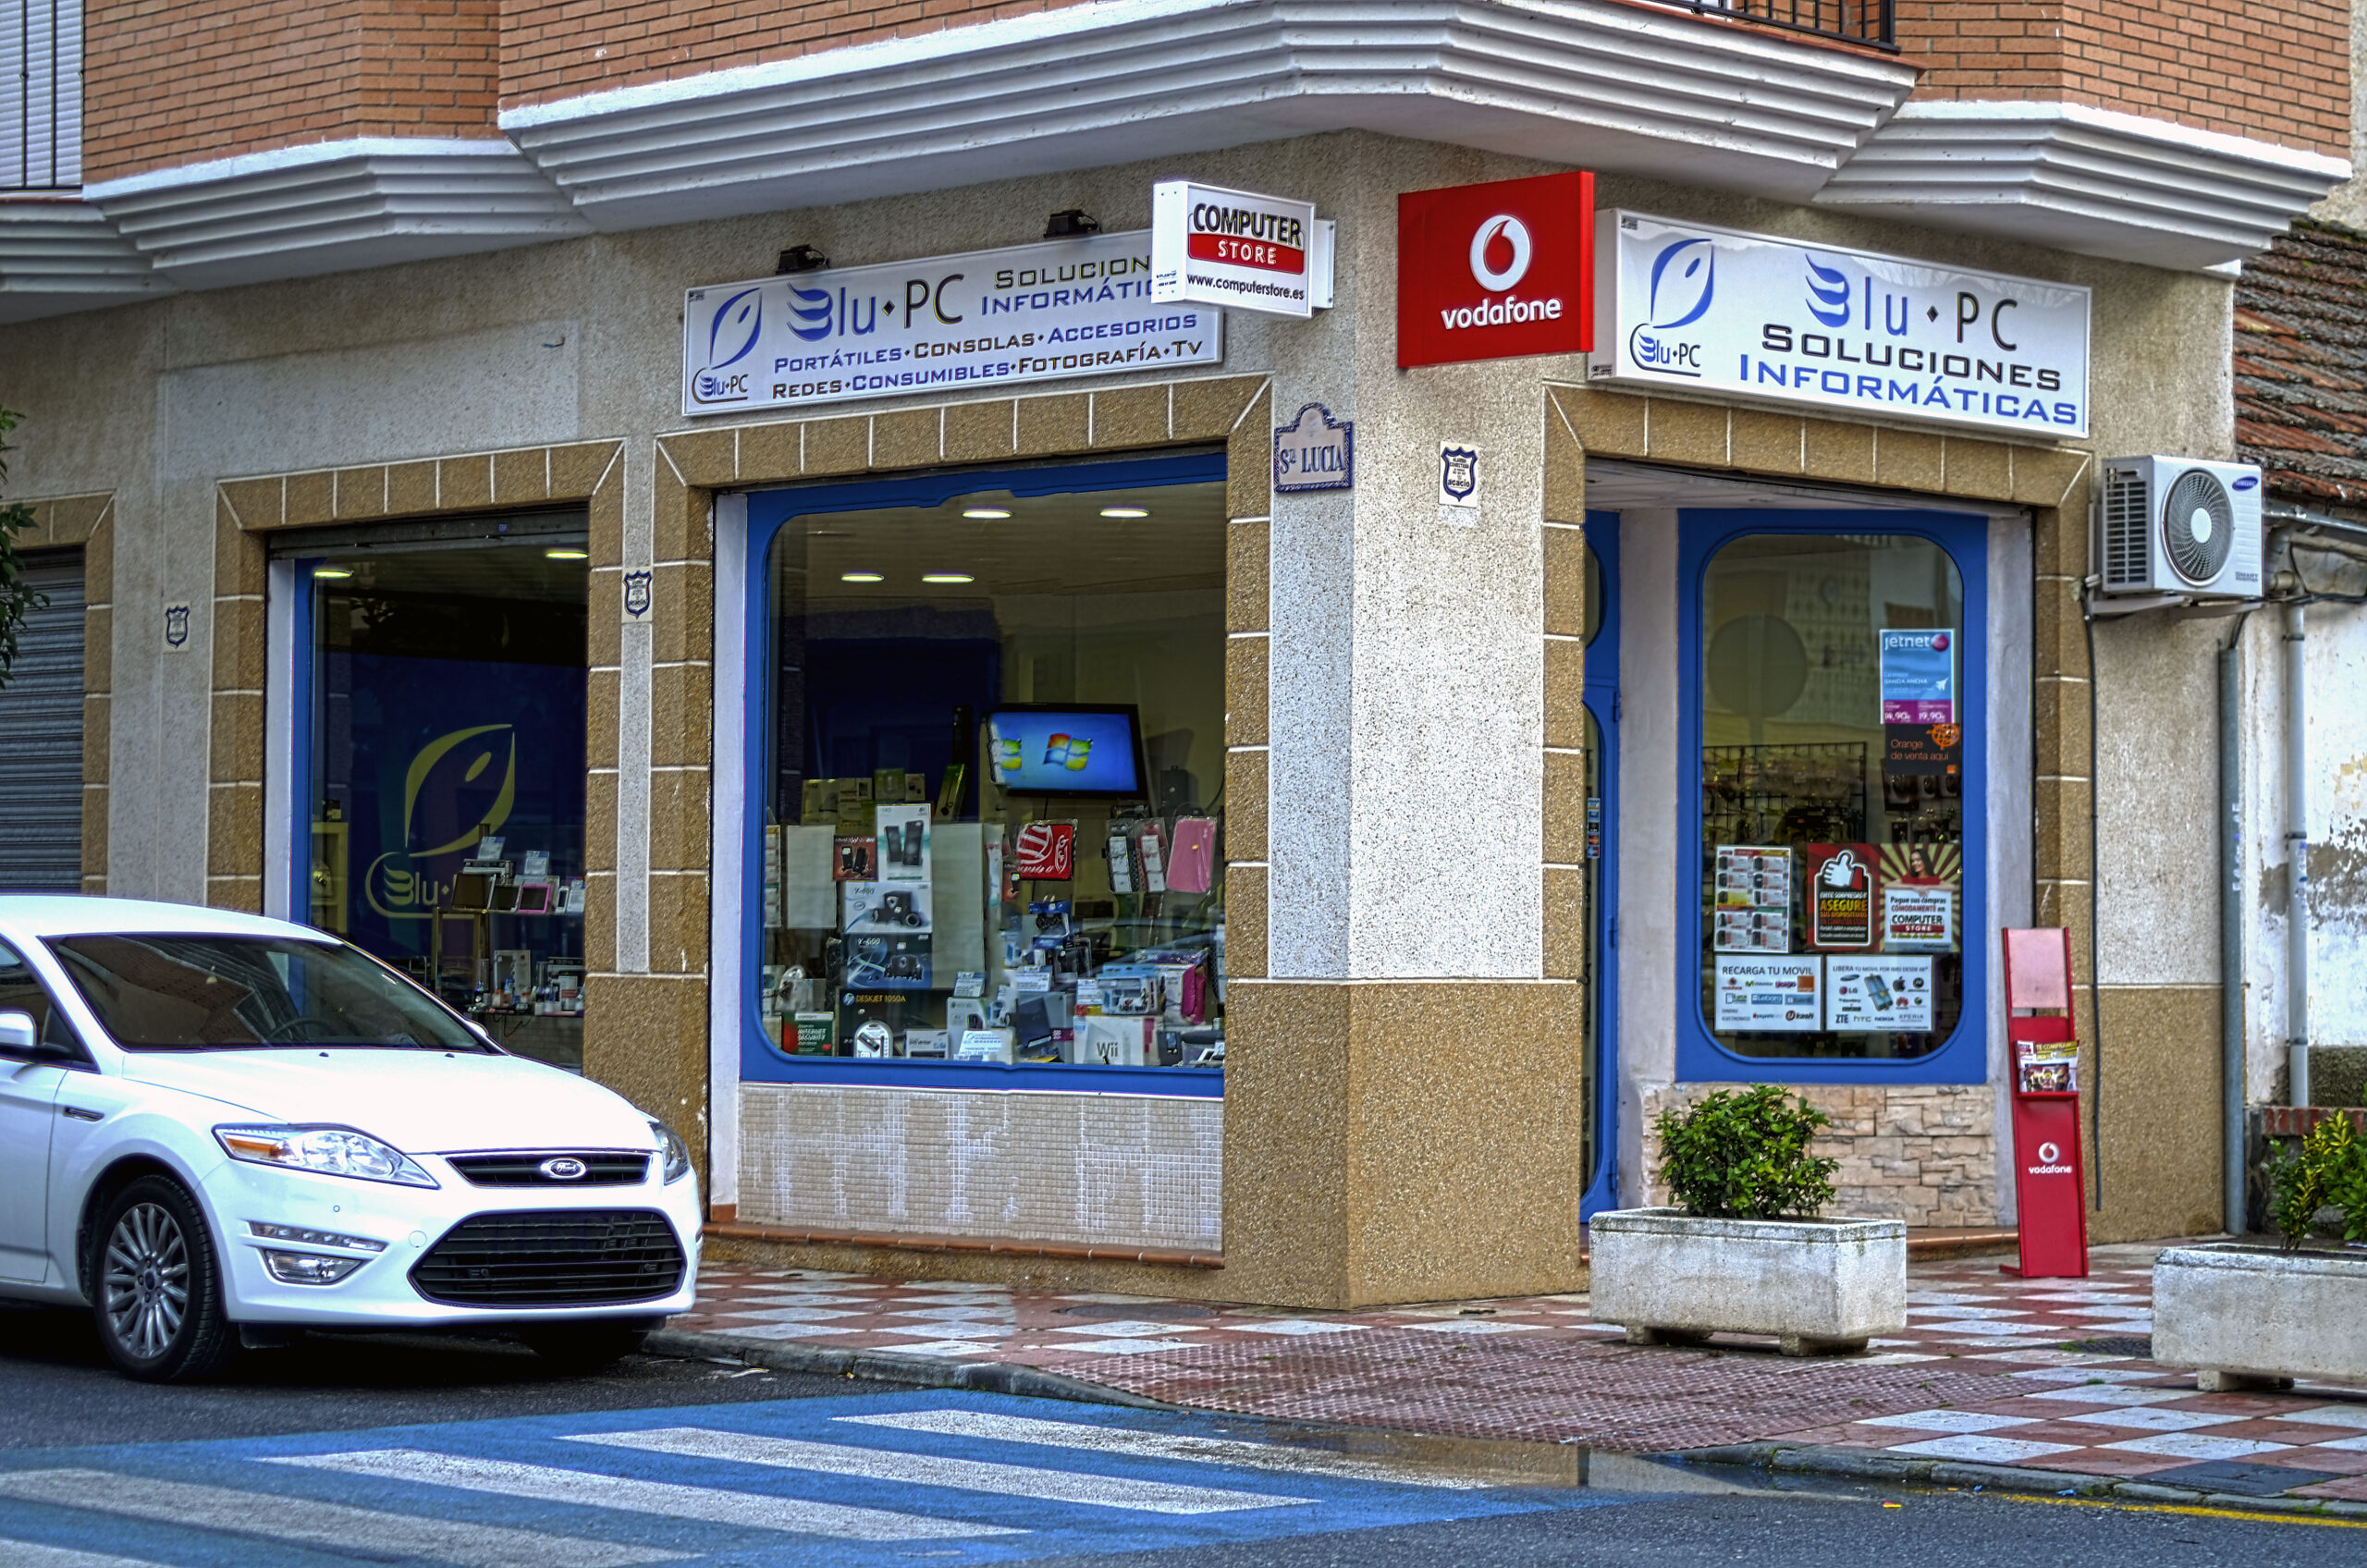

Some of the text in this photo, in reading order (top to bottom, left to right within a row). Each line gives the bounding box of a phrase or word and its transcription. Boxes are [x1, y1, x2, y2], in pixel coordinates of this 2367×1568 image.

[1192, 202, 1303, 247] COMPUTER
[1218, 239, 1277, 265] STORE
[994, 256, 1150, 288] SOLUCION
[981, 277, 1152, 315] INFORMÁTI
[1186, 273, 1305, 300] www.computerstore.es
[1441, 295, 1564, 330] vodafone
[774, 314, 1197, 374] PORTÁTILES CONSOLAS ACCESORIOS
[1761, 323, 2061, 391] SOLUCIONES
[772, 380, 842, 398] REDES
[852, 361, 1010, 391] CONSUMIBLES
[1739, 353, 2078, 425] INFORMÁTICAS
[1301, 445, 1346, 473] LUCIA
[1891, 739, 1923, 750] Orange
[1891, 752, 1902, 760] de
[1820, 900, 1868, 912] ASEGURE
[1892, 914, 1943, 925] COMPUTER
[1722, 966, 1813, 974] RECARGA TU MOVIL
[855, 995, 883, 1003] DESKJET
[1835, 1014, 1848, 1023] ZTE
[1097, 1042, 1118, 1058] Wii
[2029, 1165, 2072, 1174] vodafone
